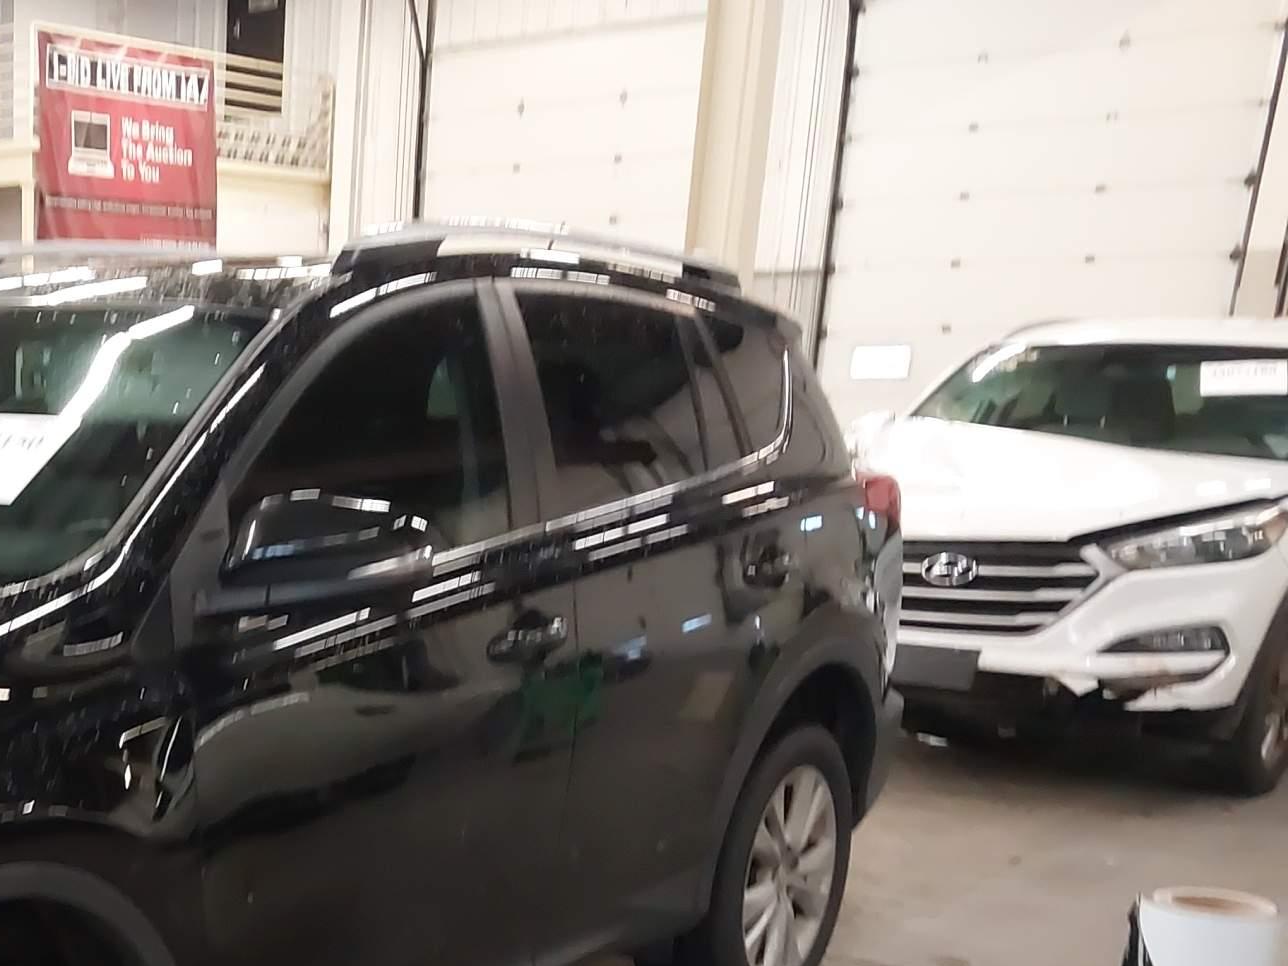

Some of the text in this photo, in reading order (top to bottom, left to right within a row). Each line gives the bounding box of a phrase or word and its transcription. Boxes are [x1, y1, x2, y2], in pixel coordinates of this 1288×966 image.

[96, 59, 129, 95] LIVE
[133, 64, 176, 101] FROM
[121, 116, 175, 146] We Bring
[121, 138, 193, 167] The Auction
[120, 159, 160, 184] To You
